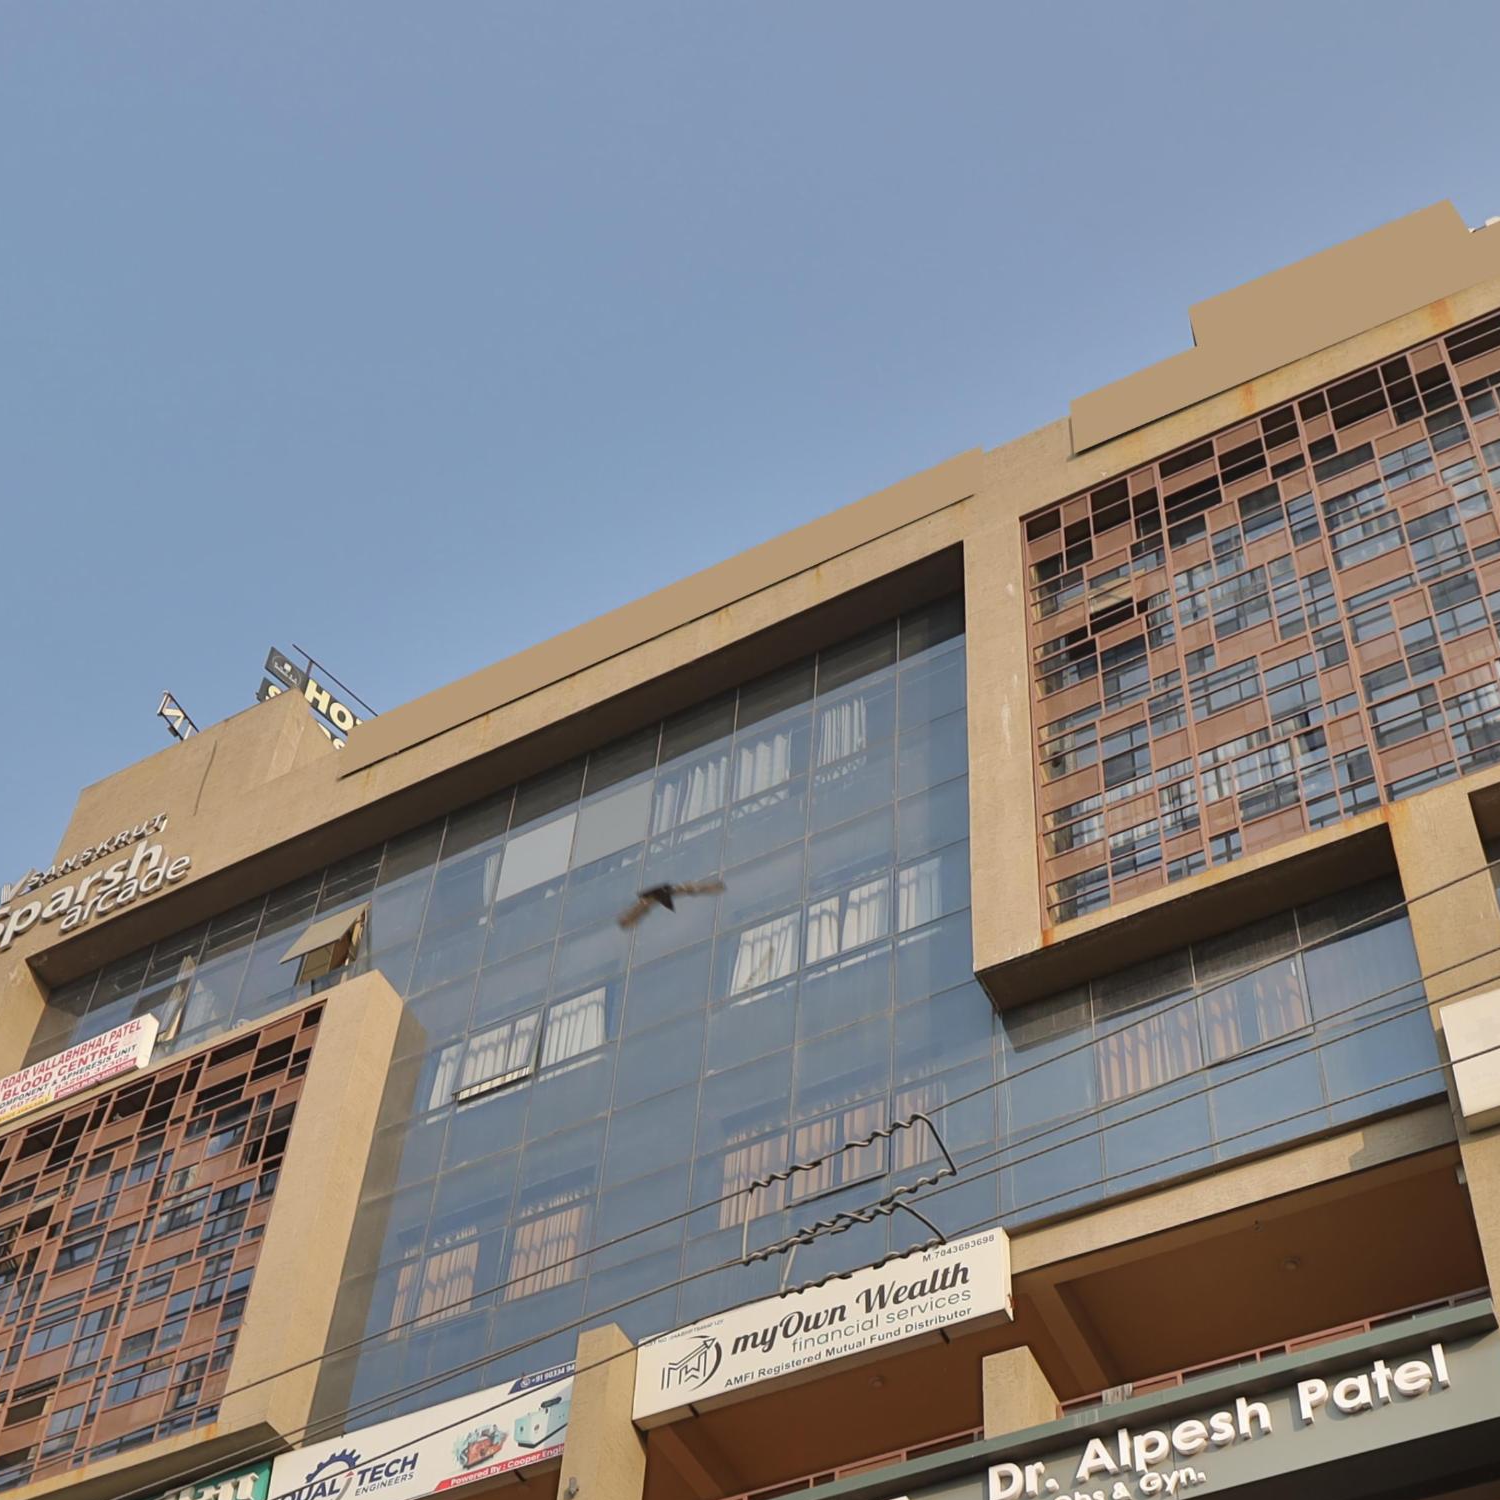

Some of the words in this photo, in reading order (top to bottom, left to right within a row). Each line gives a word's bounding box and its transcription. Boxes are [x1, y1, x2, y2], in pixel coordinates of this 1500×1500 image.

[26, 812, 167, 887] SANSKRUT
[59, 856, 190, 932] arcade
[1, 1071, 53, 1101] BLOOD
[58, 1042, 119, 1075] CENTRE
[32, 1037, 107, 1078] VALLABHBHAI
[109, 1019, 142, 1045] PATEL
[61, 1056, 112, 1083] APHERESIS
[115, 1044, 137, 1059] UNIT
[731, 1302, 847, 1356] myOwn
[855, 1262, 970, 1315] Wealth
[791, 1315, 880, 1353] financial
[885, 1289, 972, 1324] services
[724, 1371, 756, 1389] AMFI
[758, 1350, 822, 1380] Registered
[825, 1335, 867, 1359] Mutual
[869, 1327, 902, 1344] Fund
[904, 1306, 973, 1335] Distributor
[1075, 1397, 1273, 1477] Alpesh
[1296, 1341, 1452, 1424] Patel
[355, 1471, 415, 1497] ENGINEERS
[357, 1452, 420, 1488] TECH
[450, 1466, 489, 1487] Powered
[507, 1452, 542, 1470] Cooper
[1139, 1463, 1207, 1497] Gyn.
